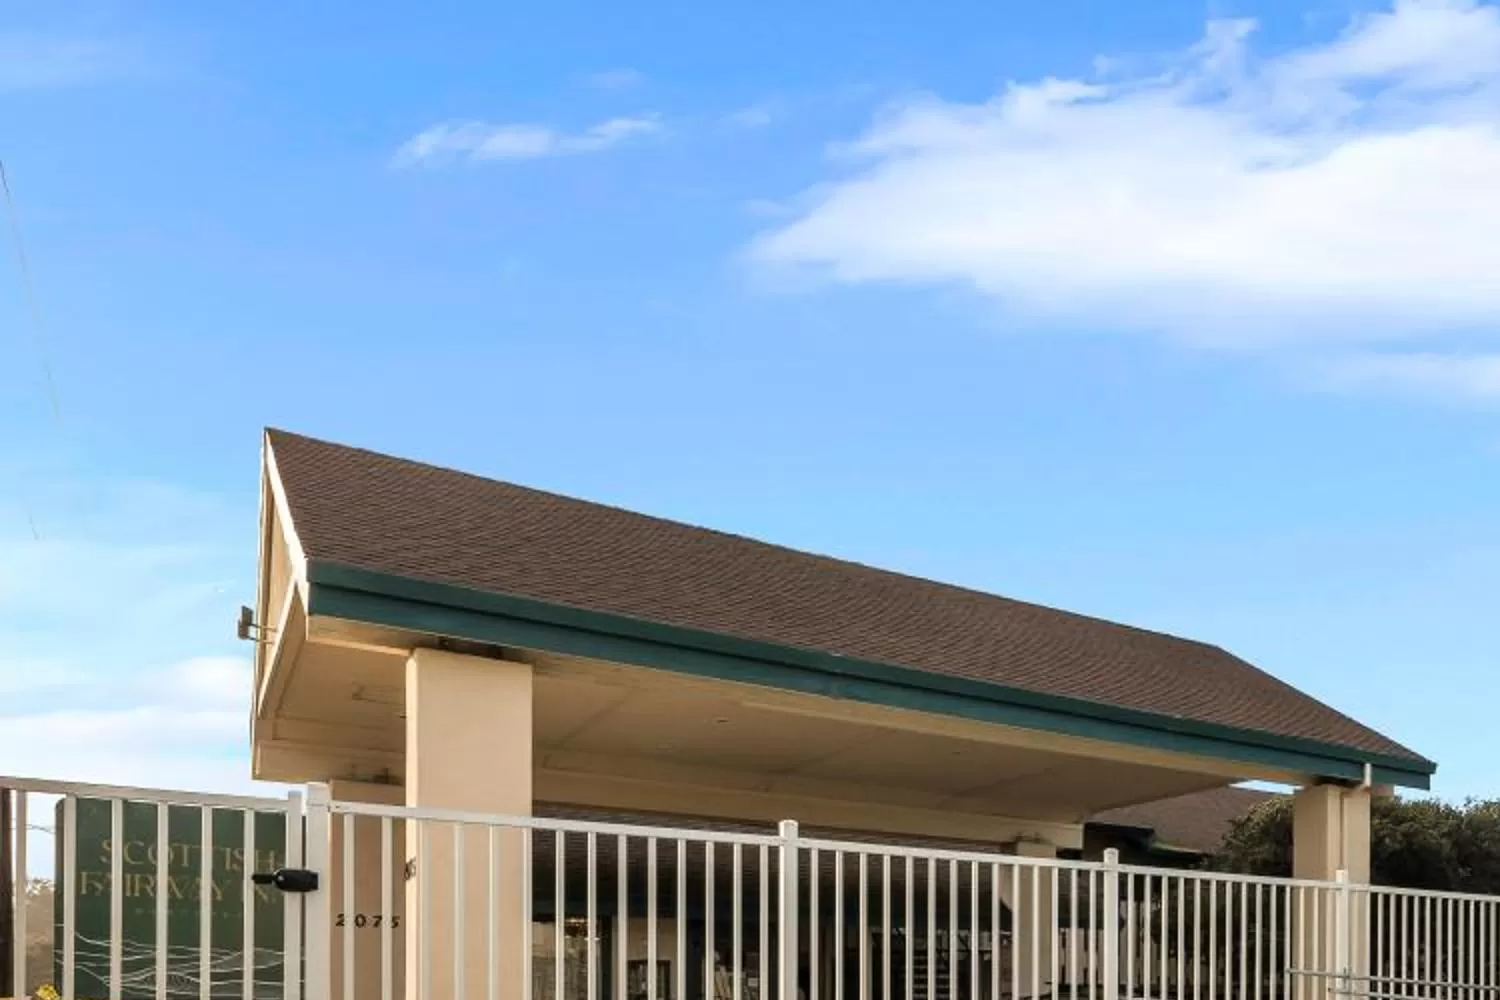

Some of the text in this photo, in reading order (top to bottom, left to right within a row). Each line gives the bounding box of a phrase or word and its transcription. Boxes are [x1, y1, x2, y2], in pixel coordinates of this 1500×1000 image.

[100, 839, 276, 871] SCOTISH
[79, 871, 235, 901] FIRWY
[335, 913, 400, 928] 2075
